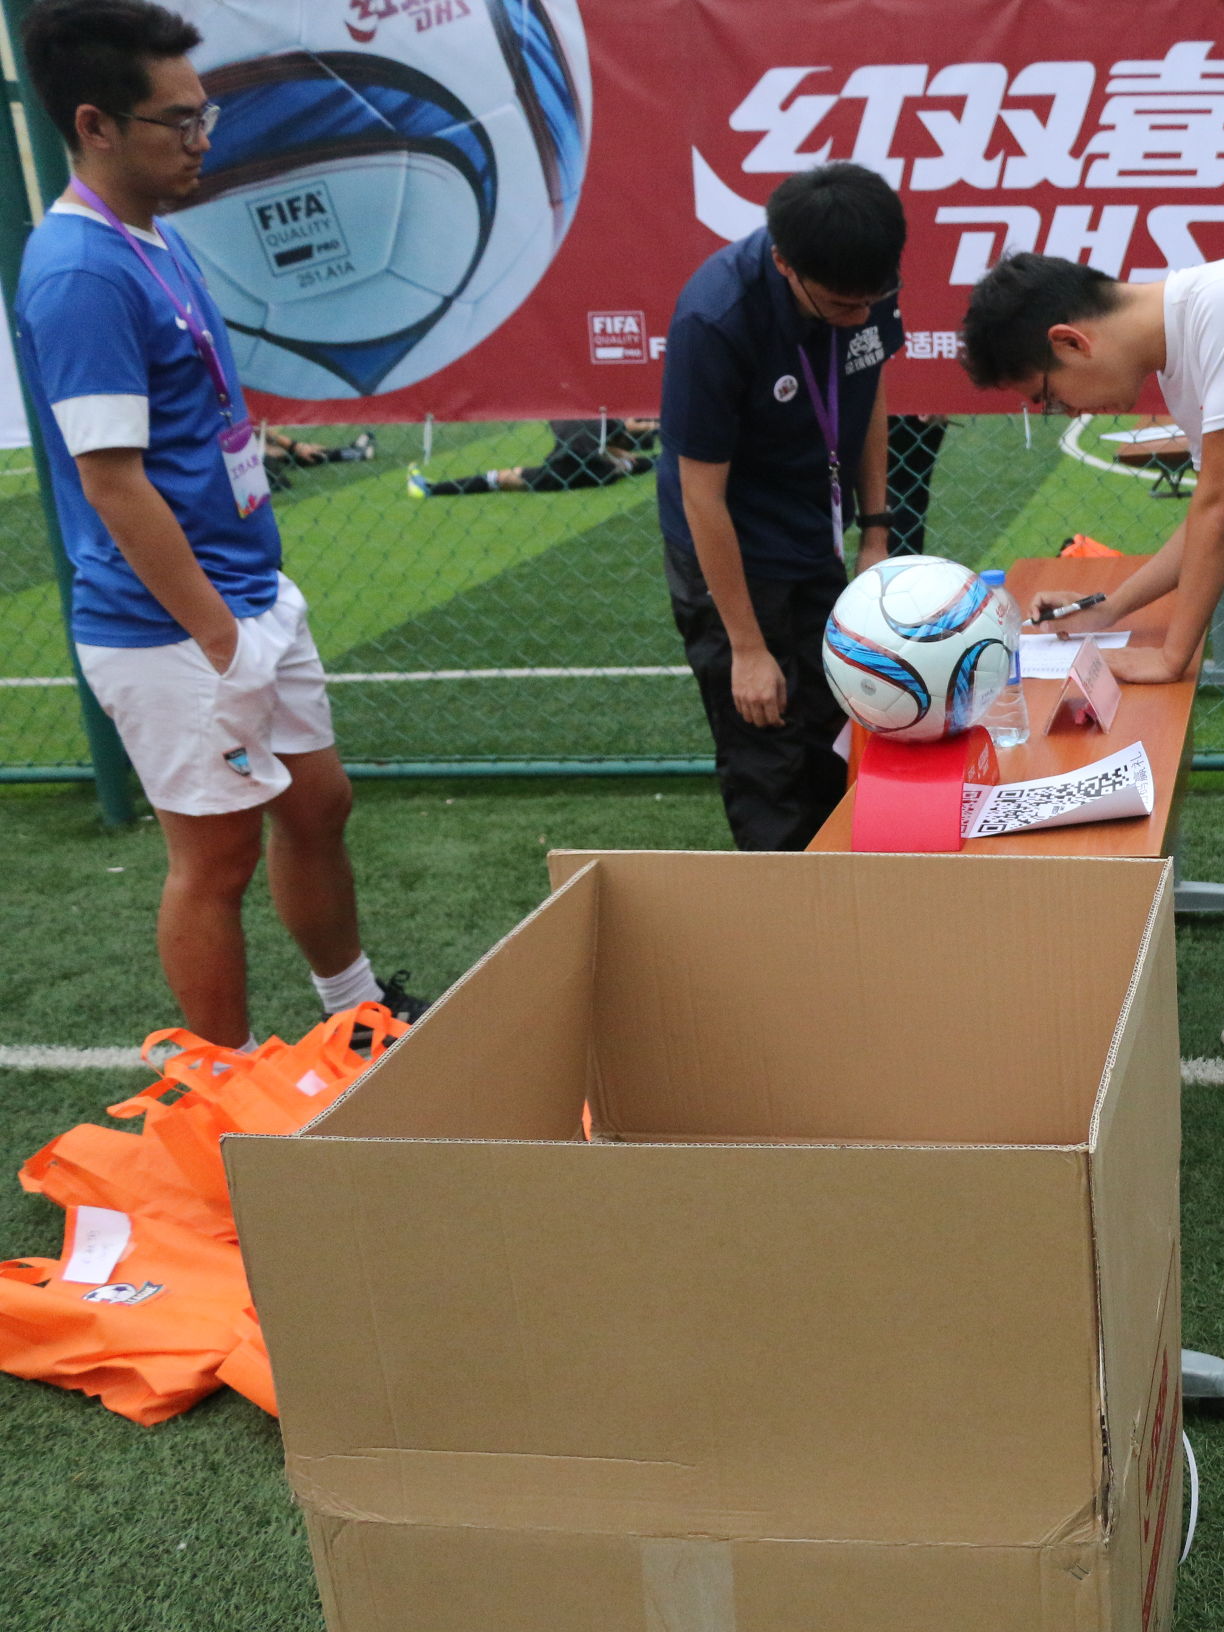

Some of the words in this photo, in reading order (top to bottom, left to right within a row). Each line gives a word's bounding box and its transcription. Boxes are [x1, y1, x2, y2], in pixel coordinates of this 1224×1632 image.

[256, 192, 328, 231] FIFA
[265, 218, 331, 248] QUALITY
[593, 315, 640, 334] FIFA
[904, 331, 967, 360] 适用
